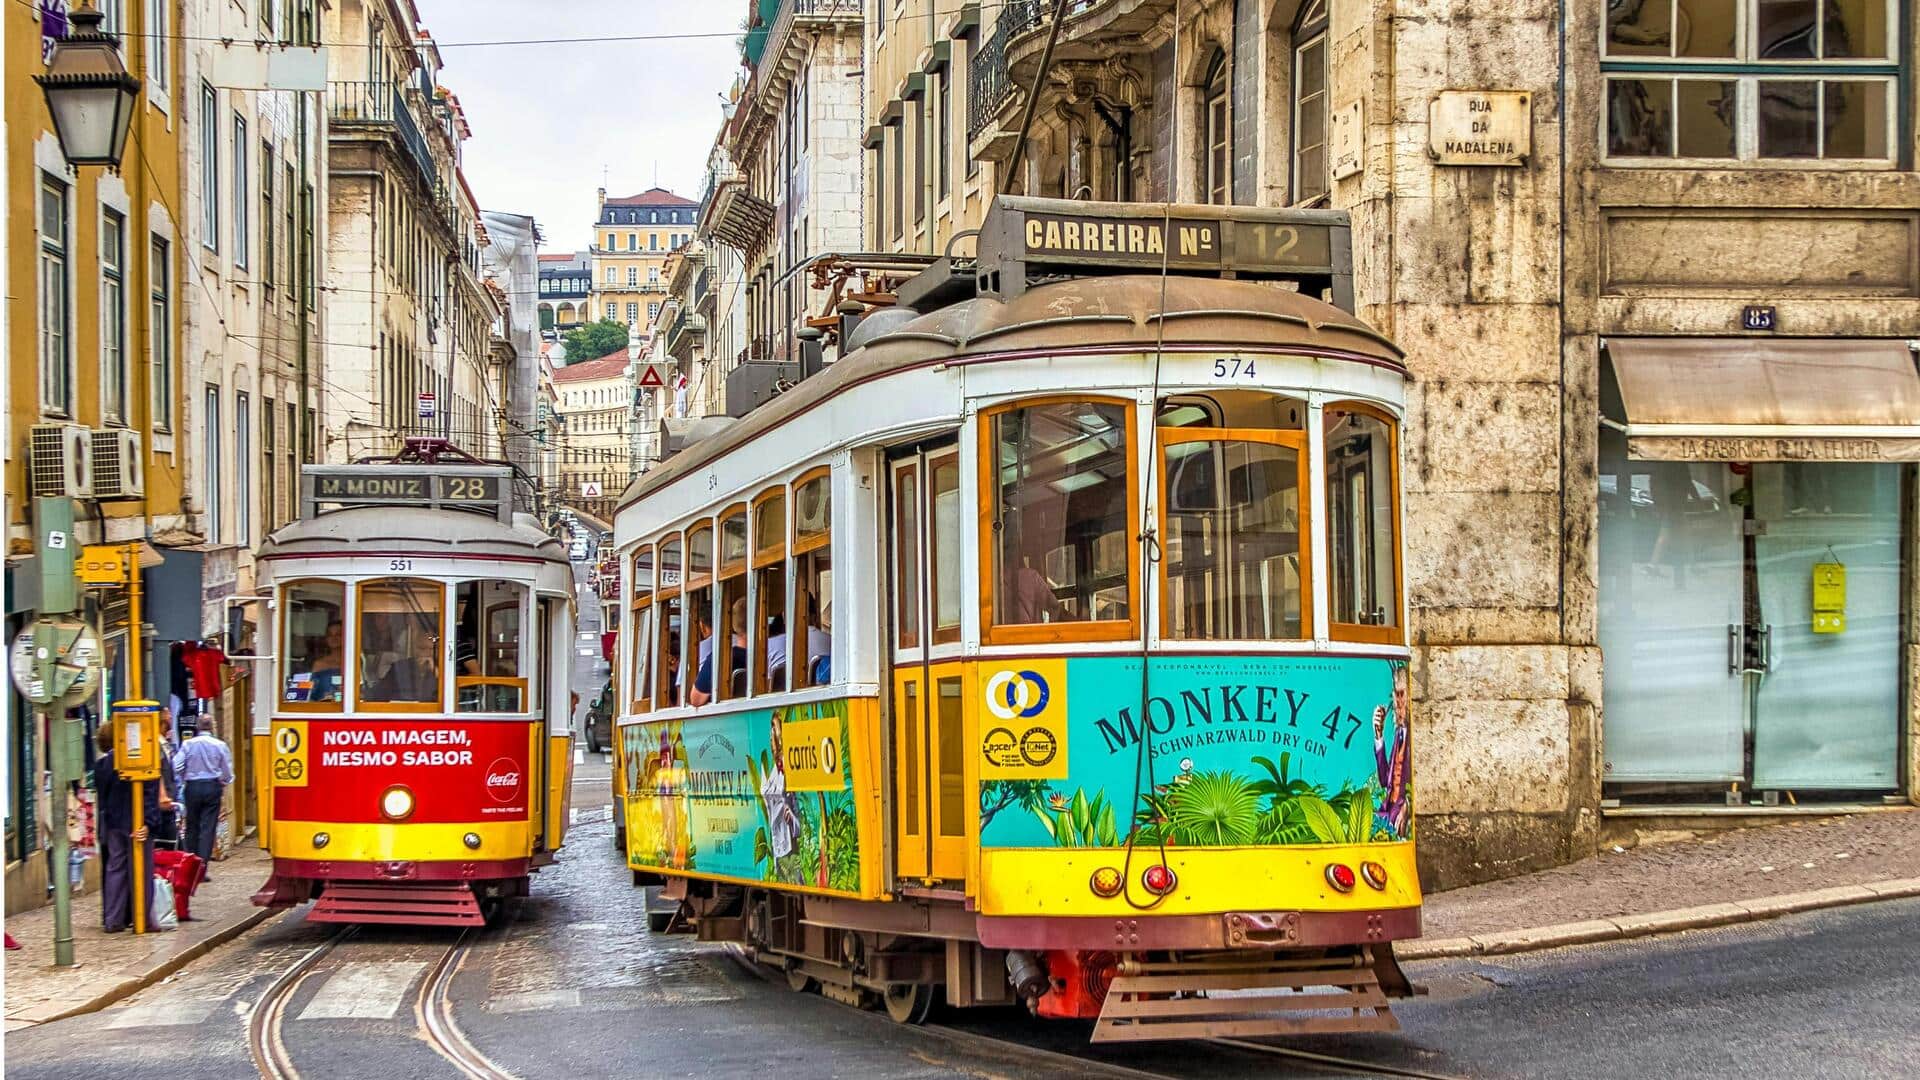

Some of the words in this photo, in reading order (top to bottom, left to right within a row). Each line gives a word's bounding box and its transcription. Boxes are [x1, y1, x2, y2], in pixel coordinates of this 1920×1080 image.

[1469, 100, 1493, 113] RUA
[1472, 121, 1488, 133] DA
[1445, 141, 1515, 154] MADALENA
[1025, 219, 1165, 255] CARREIRA
[1179, 226, 1212, 257] Nº
[1252, 225, 1299, 262] 12
[1214, 358, 1257, 379] 574
[322, 479, 343, 495] M.
[347, 479, 421, 495] MONIZ
[450, 478, 486, 499] 28
[390, 560, 413, 571] 551
[1094, 685, 1310, 755] MONKEY
[1321, 705, 1363, 750] 47
[323, 730, 377, 746] NOVA
[382, 729, 473, 747] IMAGEM,
[1151, 729, 1267, 760] SCHWARZWALD
[1272, 731, 1301, 748] DRY
[1304, 738, 1328, 758] GIN
[322, 751, 398, 767] MESMO
[402, 750, 473, 766] SABOR
[788, 735, 818, 770] carris
[690, 770, 735, 807] MONKEY
